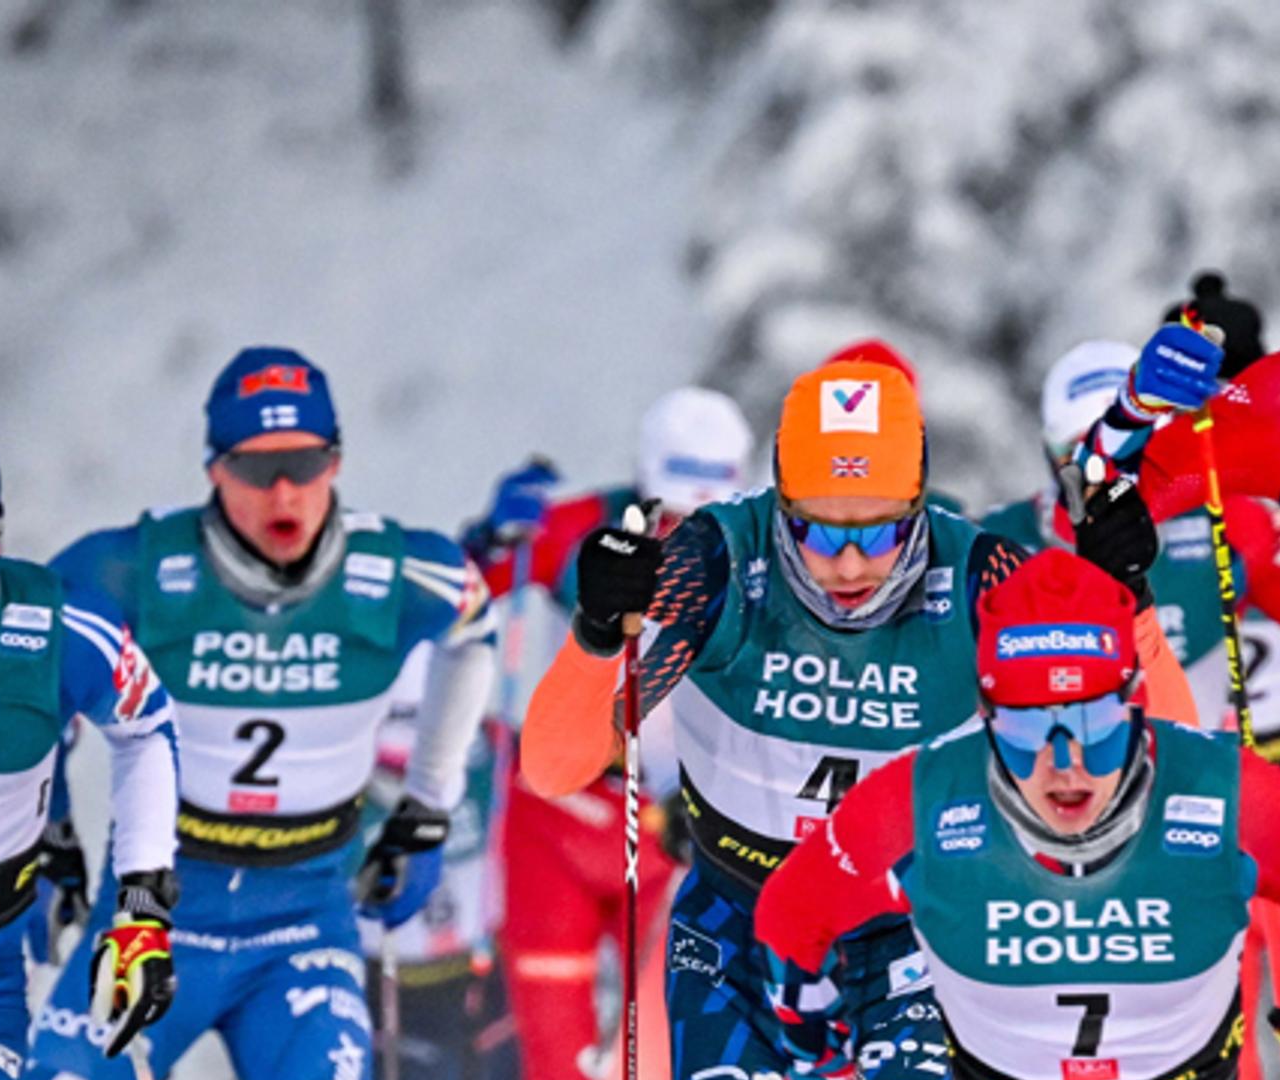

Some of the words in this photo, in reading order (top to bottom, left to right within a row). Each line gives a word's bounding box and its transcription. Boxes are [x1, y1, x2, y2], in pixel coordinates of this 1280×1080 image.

[193, 631, 341, 662] POLAR
[997, 629, 1099, 658] SpareBank
[1102, 632, 1115, 652] 1
[187, 661, 341, 693] HOUSE
[762, 652, 919, 696] POLAR
[753, 689, 921, 729] HOUSE
[231, 718, 286, 787] 2
[796, 756, 860, 815] 4
[1165, 826, 1221, 848] coop
[987, 898, 1172, 931] POLAR
[987, 934, 1175, 966] HOUSE
[1055, 993, 1110, 1057] 7
